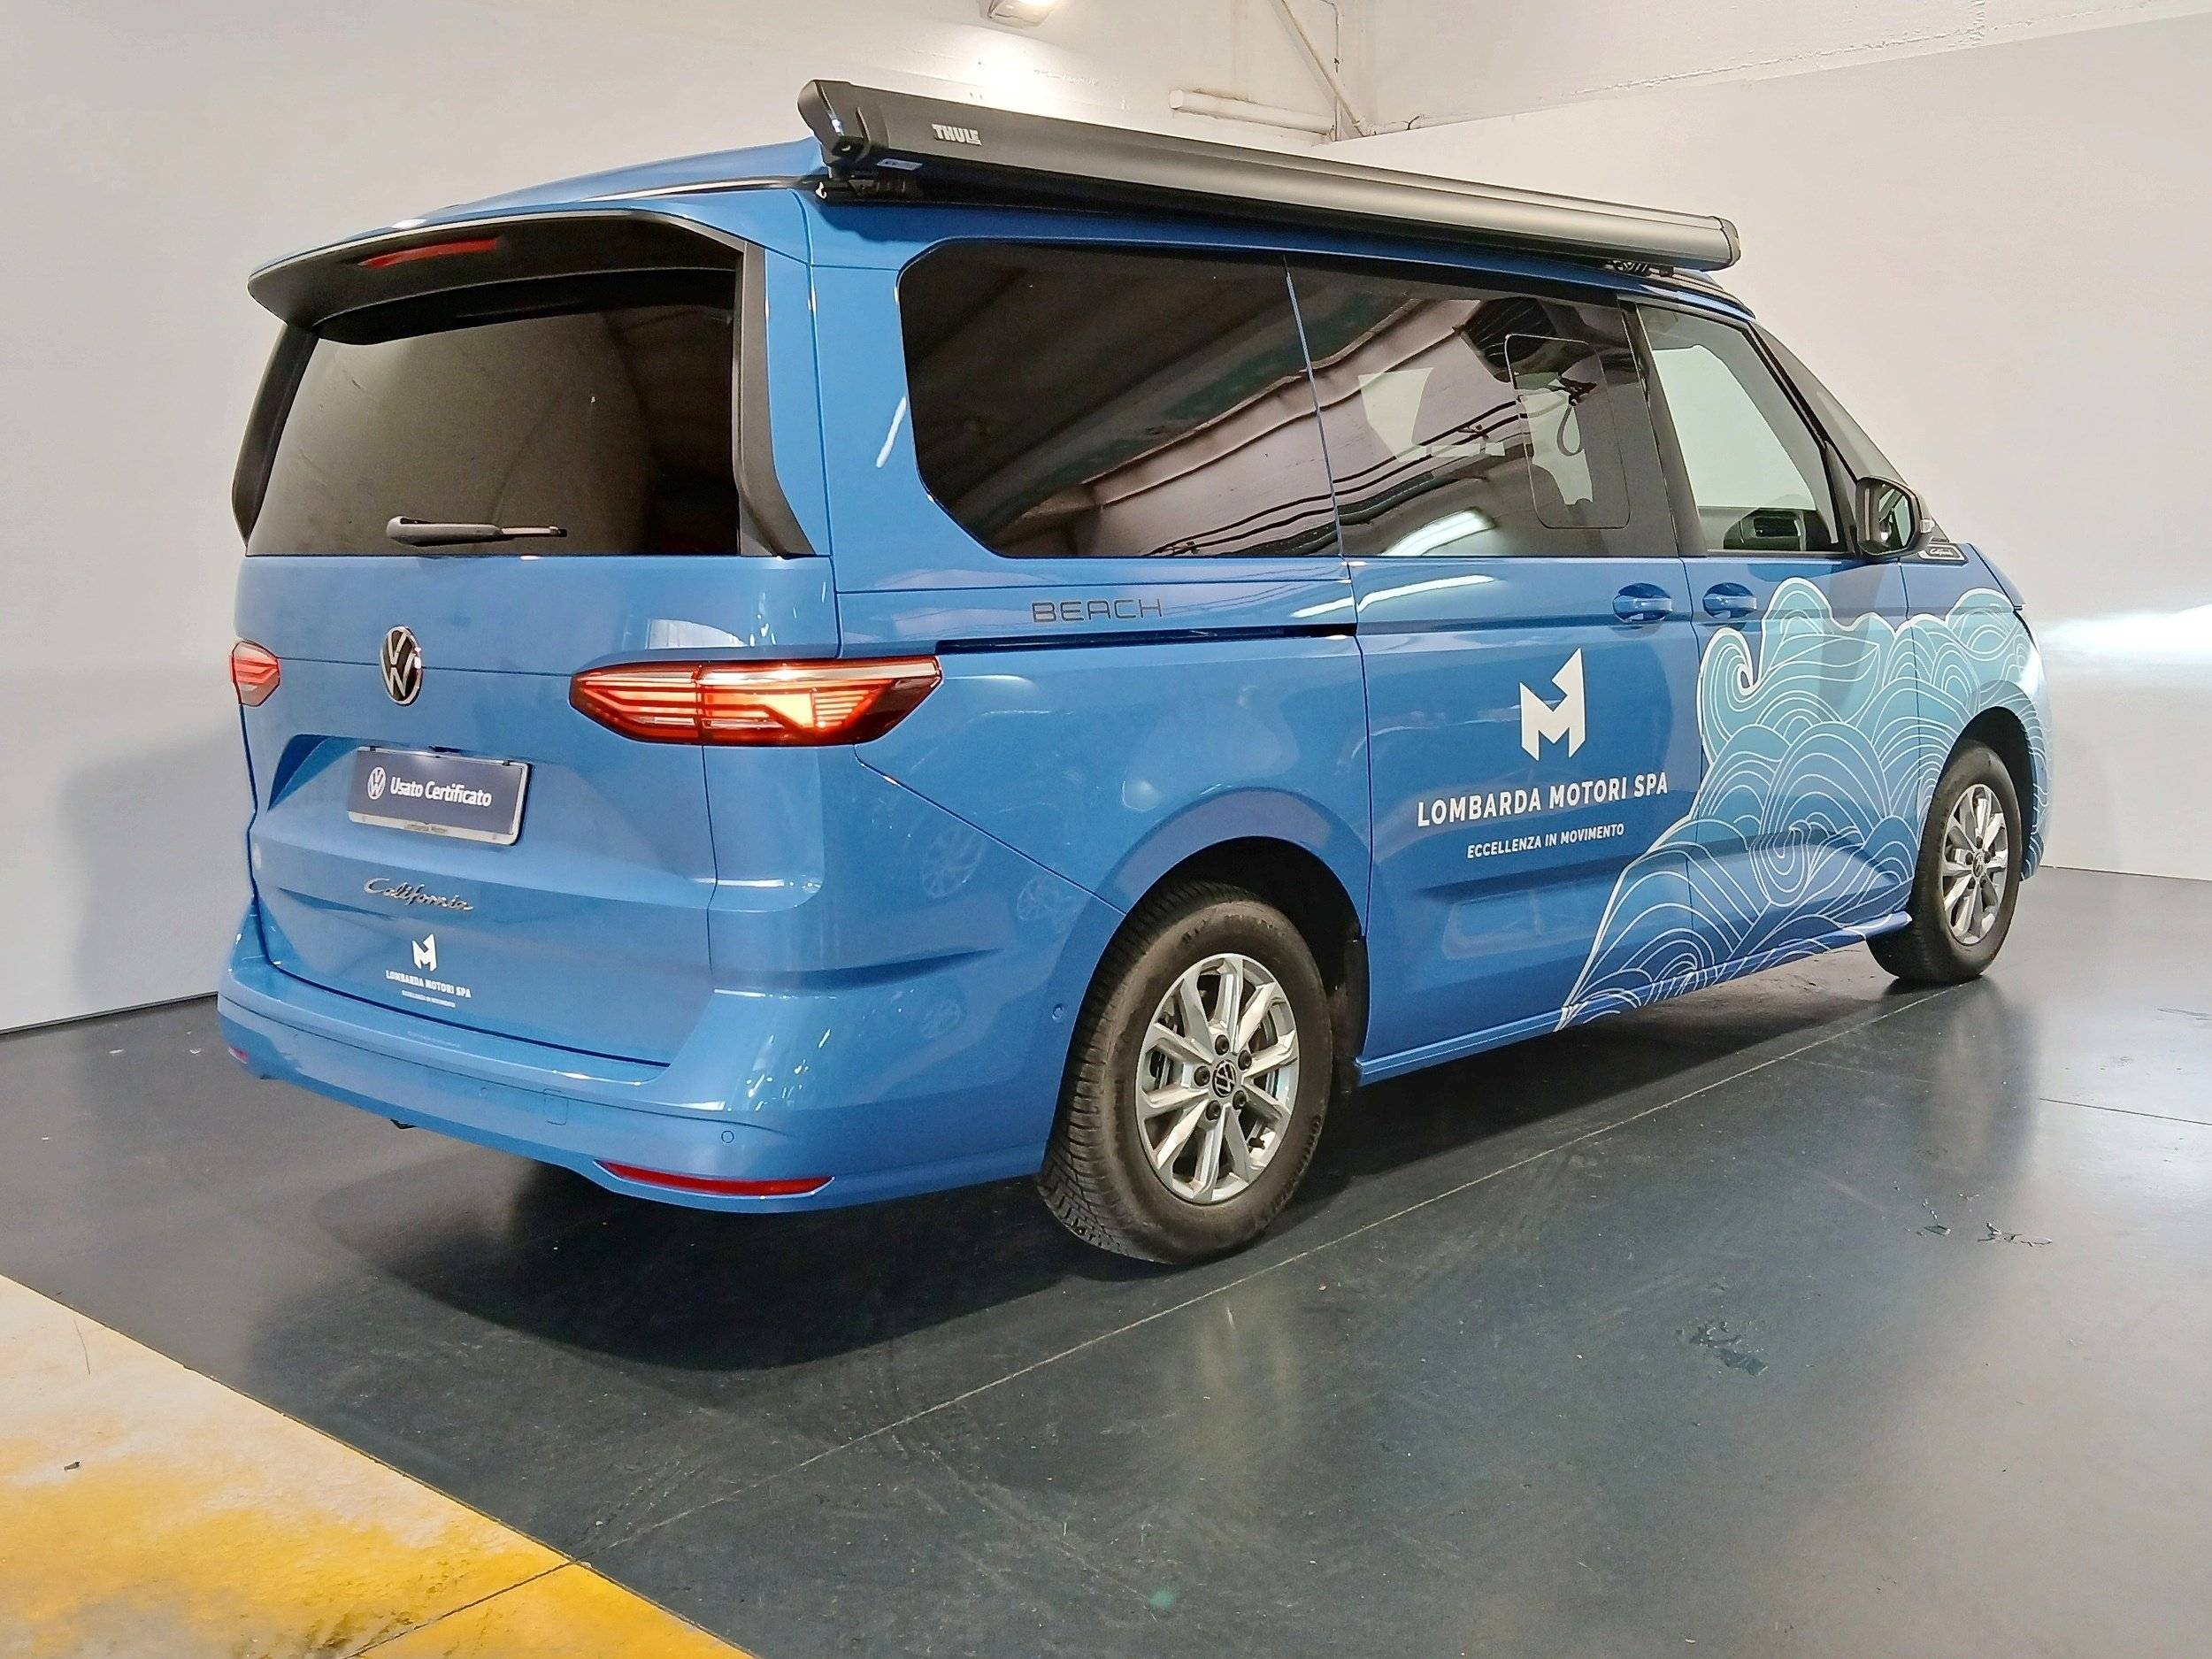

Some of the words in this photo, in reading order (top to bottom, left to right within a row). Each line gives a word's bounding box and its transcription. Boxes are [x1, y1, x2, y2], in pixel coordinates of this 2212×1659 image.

[931, 123, 982, 146] THULE
[1032, 598, 1163, 623] BEACH
[390, 776, 424, 798] Usato
[425, 780, 492, 807] Certificato
[1417, 787, 1541, 827] LOMBARDA
[1548, 777, 1627, 810] MOTORI
[1633, 772, 1668, 797] SPA
[1467, 833, 1541, 859] ECCELLENZA
[1545, 832, 1558, 848] IN
[1560, 823, 1624, 844] MOVIMENTO
[364, 878, 474, 910] California
[456, 987, 472, 998] SPA
